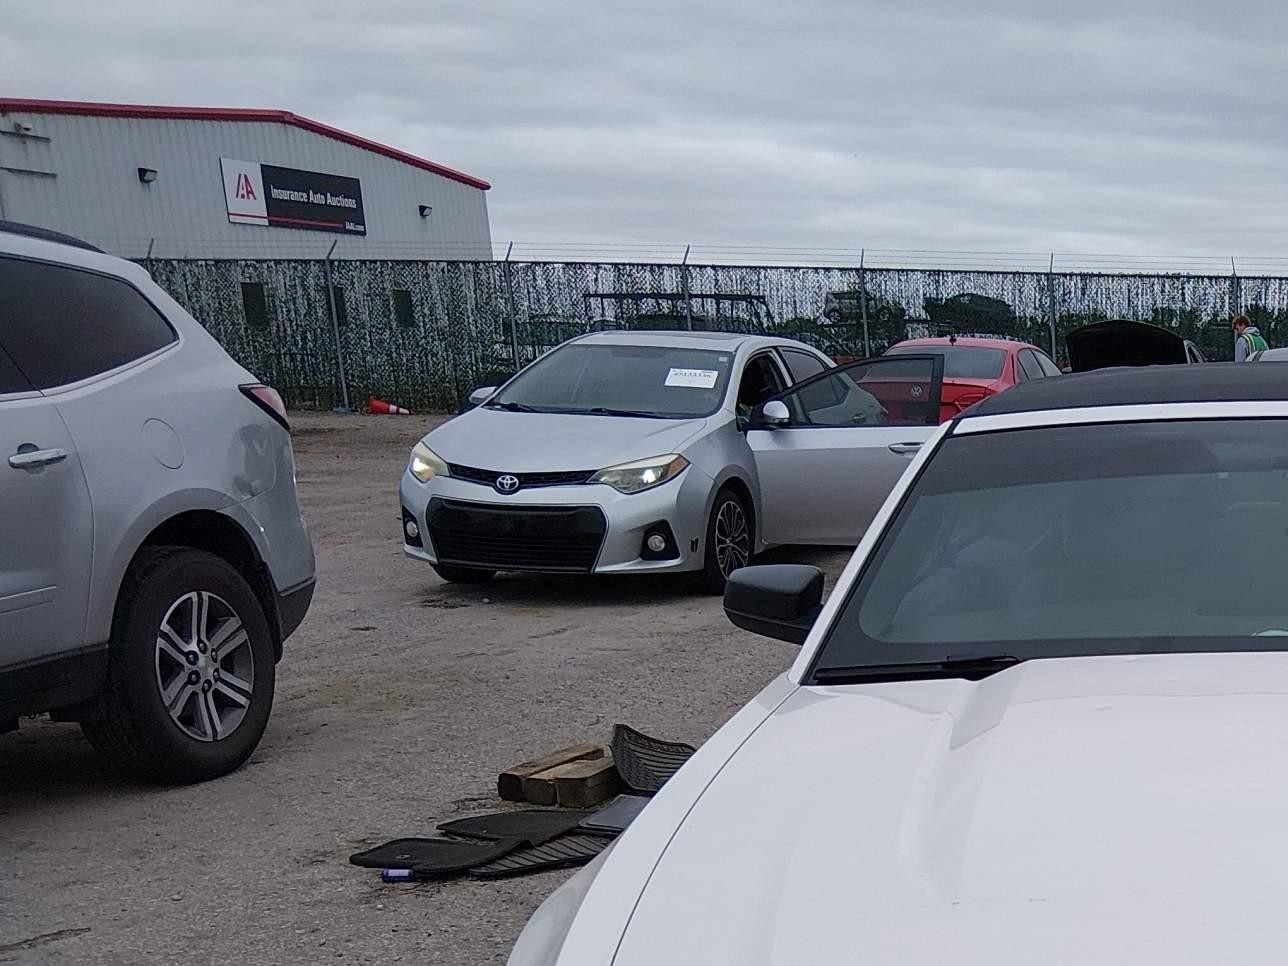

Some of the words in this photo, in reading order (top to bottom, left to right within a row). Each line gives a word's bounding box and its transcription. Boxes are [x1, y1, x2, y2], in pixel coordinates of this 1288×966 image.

[271, 184, 308, 203] Insurance
[309, 189, 326, 205] Auto
[327, 193, 357, 209] Auctions
